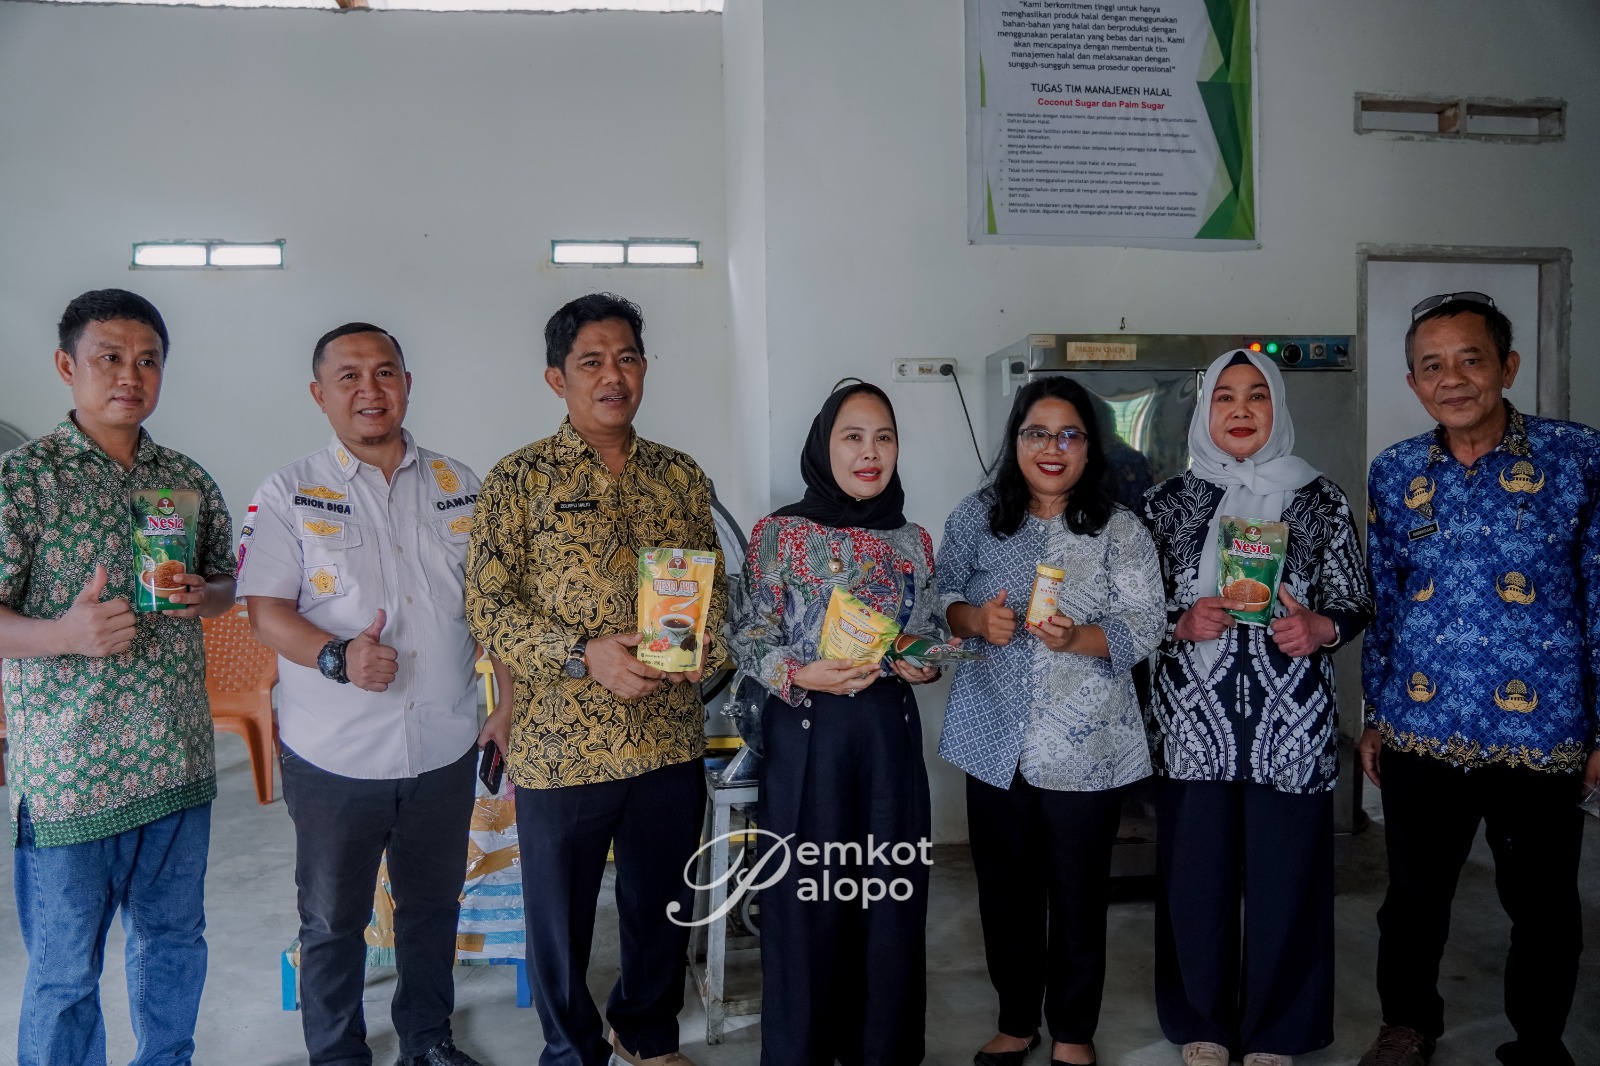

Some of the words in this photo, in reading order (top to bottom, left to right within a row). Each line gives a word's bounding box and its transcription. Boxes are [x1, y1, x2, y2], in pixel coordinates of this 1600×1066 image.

[1044, 2, 1092, 10] berkomitmen
[1095, 3, 1115, 13] tinggi
[1140, 5, 1161, 14] hanya
[1002, 11, 1052, 21] menghasilkan
[1054, 13, 1079, 22] produk
[1102, 14, 1127, 24] dengan
[1130, 15, 1178, 26] menggunakan
[1004, 21, 1050, 29] bahan-bahan
[1108, 24, 1149, 34] berproduksi
[1152, 26, 1177, 35] dengan
[998, 31, 1048, 41] menggunakan
[1050, 32, 1085, 42] peralatan
[1146, 36, 1164, 45] najis.
[1033, 41, 1081, 52] mencapainya
[1084, 43, 1109, 53] dengan
[1112, 44, 1153, 52] membentuk
[1012, 51, 1054, 61] manajemen
[1093, 53, 1142, 62] melaksanakan
[1145, 55, 1170, 64] dengan
[1009, 61, 1070, 72] sungguh-sungguh
[1098, 64, 1128, 74] prosedur
[1132, 65, 1176, 75] operasional"
[1031, 84, 1062, 93] TUGAS
[1067, 85, 1082, 94] TIM
[1085, 86, 1140, 96] MANAJEMEN
[1144, 88, 1172, 97] HALAL
[1076, 100, 1099, 110] Sugar
[1142, 102, 1165, 112] Sugar
[437, 495, 478, 510] CAMAT
[148, 514, 184, 528] Nesia
[1233, 539, 1270, 553] Nesia
